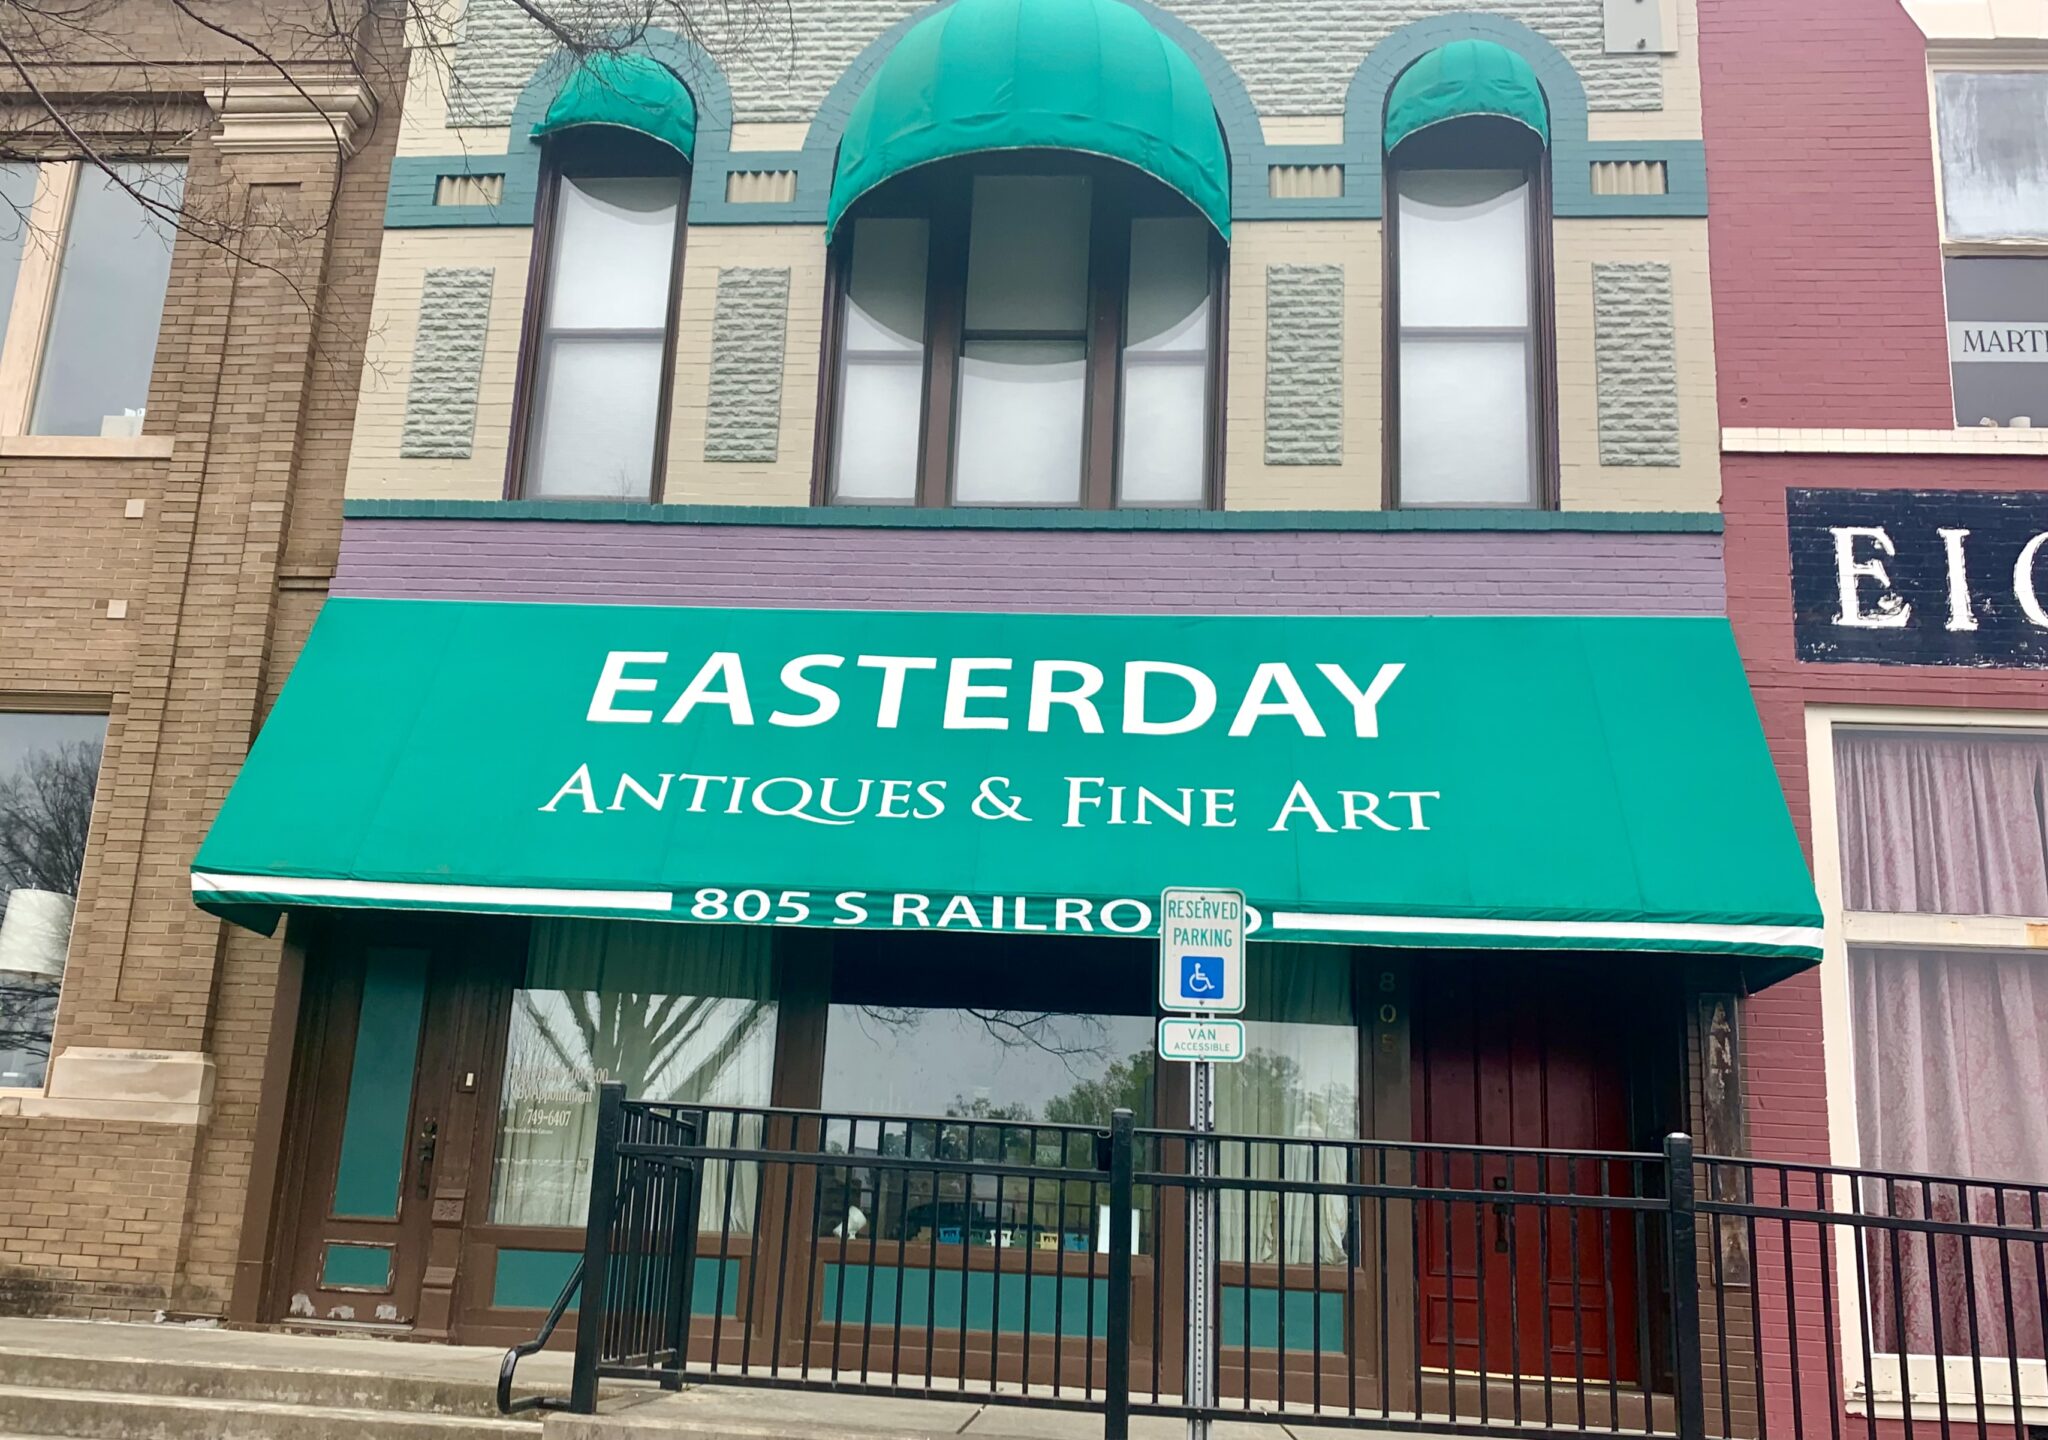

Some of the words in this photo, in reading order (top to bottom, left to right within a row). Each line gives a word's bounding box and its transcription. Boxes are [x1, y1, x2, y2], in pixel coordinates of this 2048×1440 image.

[586, 651, 1405, 738] EASTERDAY
[538, 763, 948, 826] ANTIQUES
[971, 776, 1032, 821] &
[1063, 777, 1236, 829] FINE
[1269, 780, 1440, 833] ART
[691, 888, 810, 924] 805
[833, 891, 868, 925] S
[892, 893, 1262, 935] RAILRO
[1168, 900, 1238, 920] RESERVED
[1173, 927, 1233, 948] PARKING
[1188, 1028, 1216, 1041] VAN
[1174, 1042, 1230, 1052] ACCESSIBLE
[531, 1086, 593, 1105] Appointment
